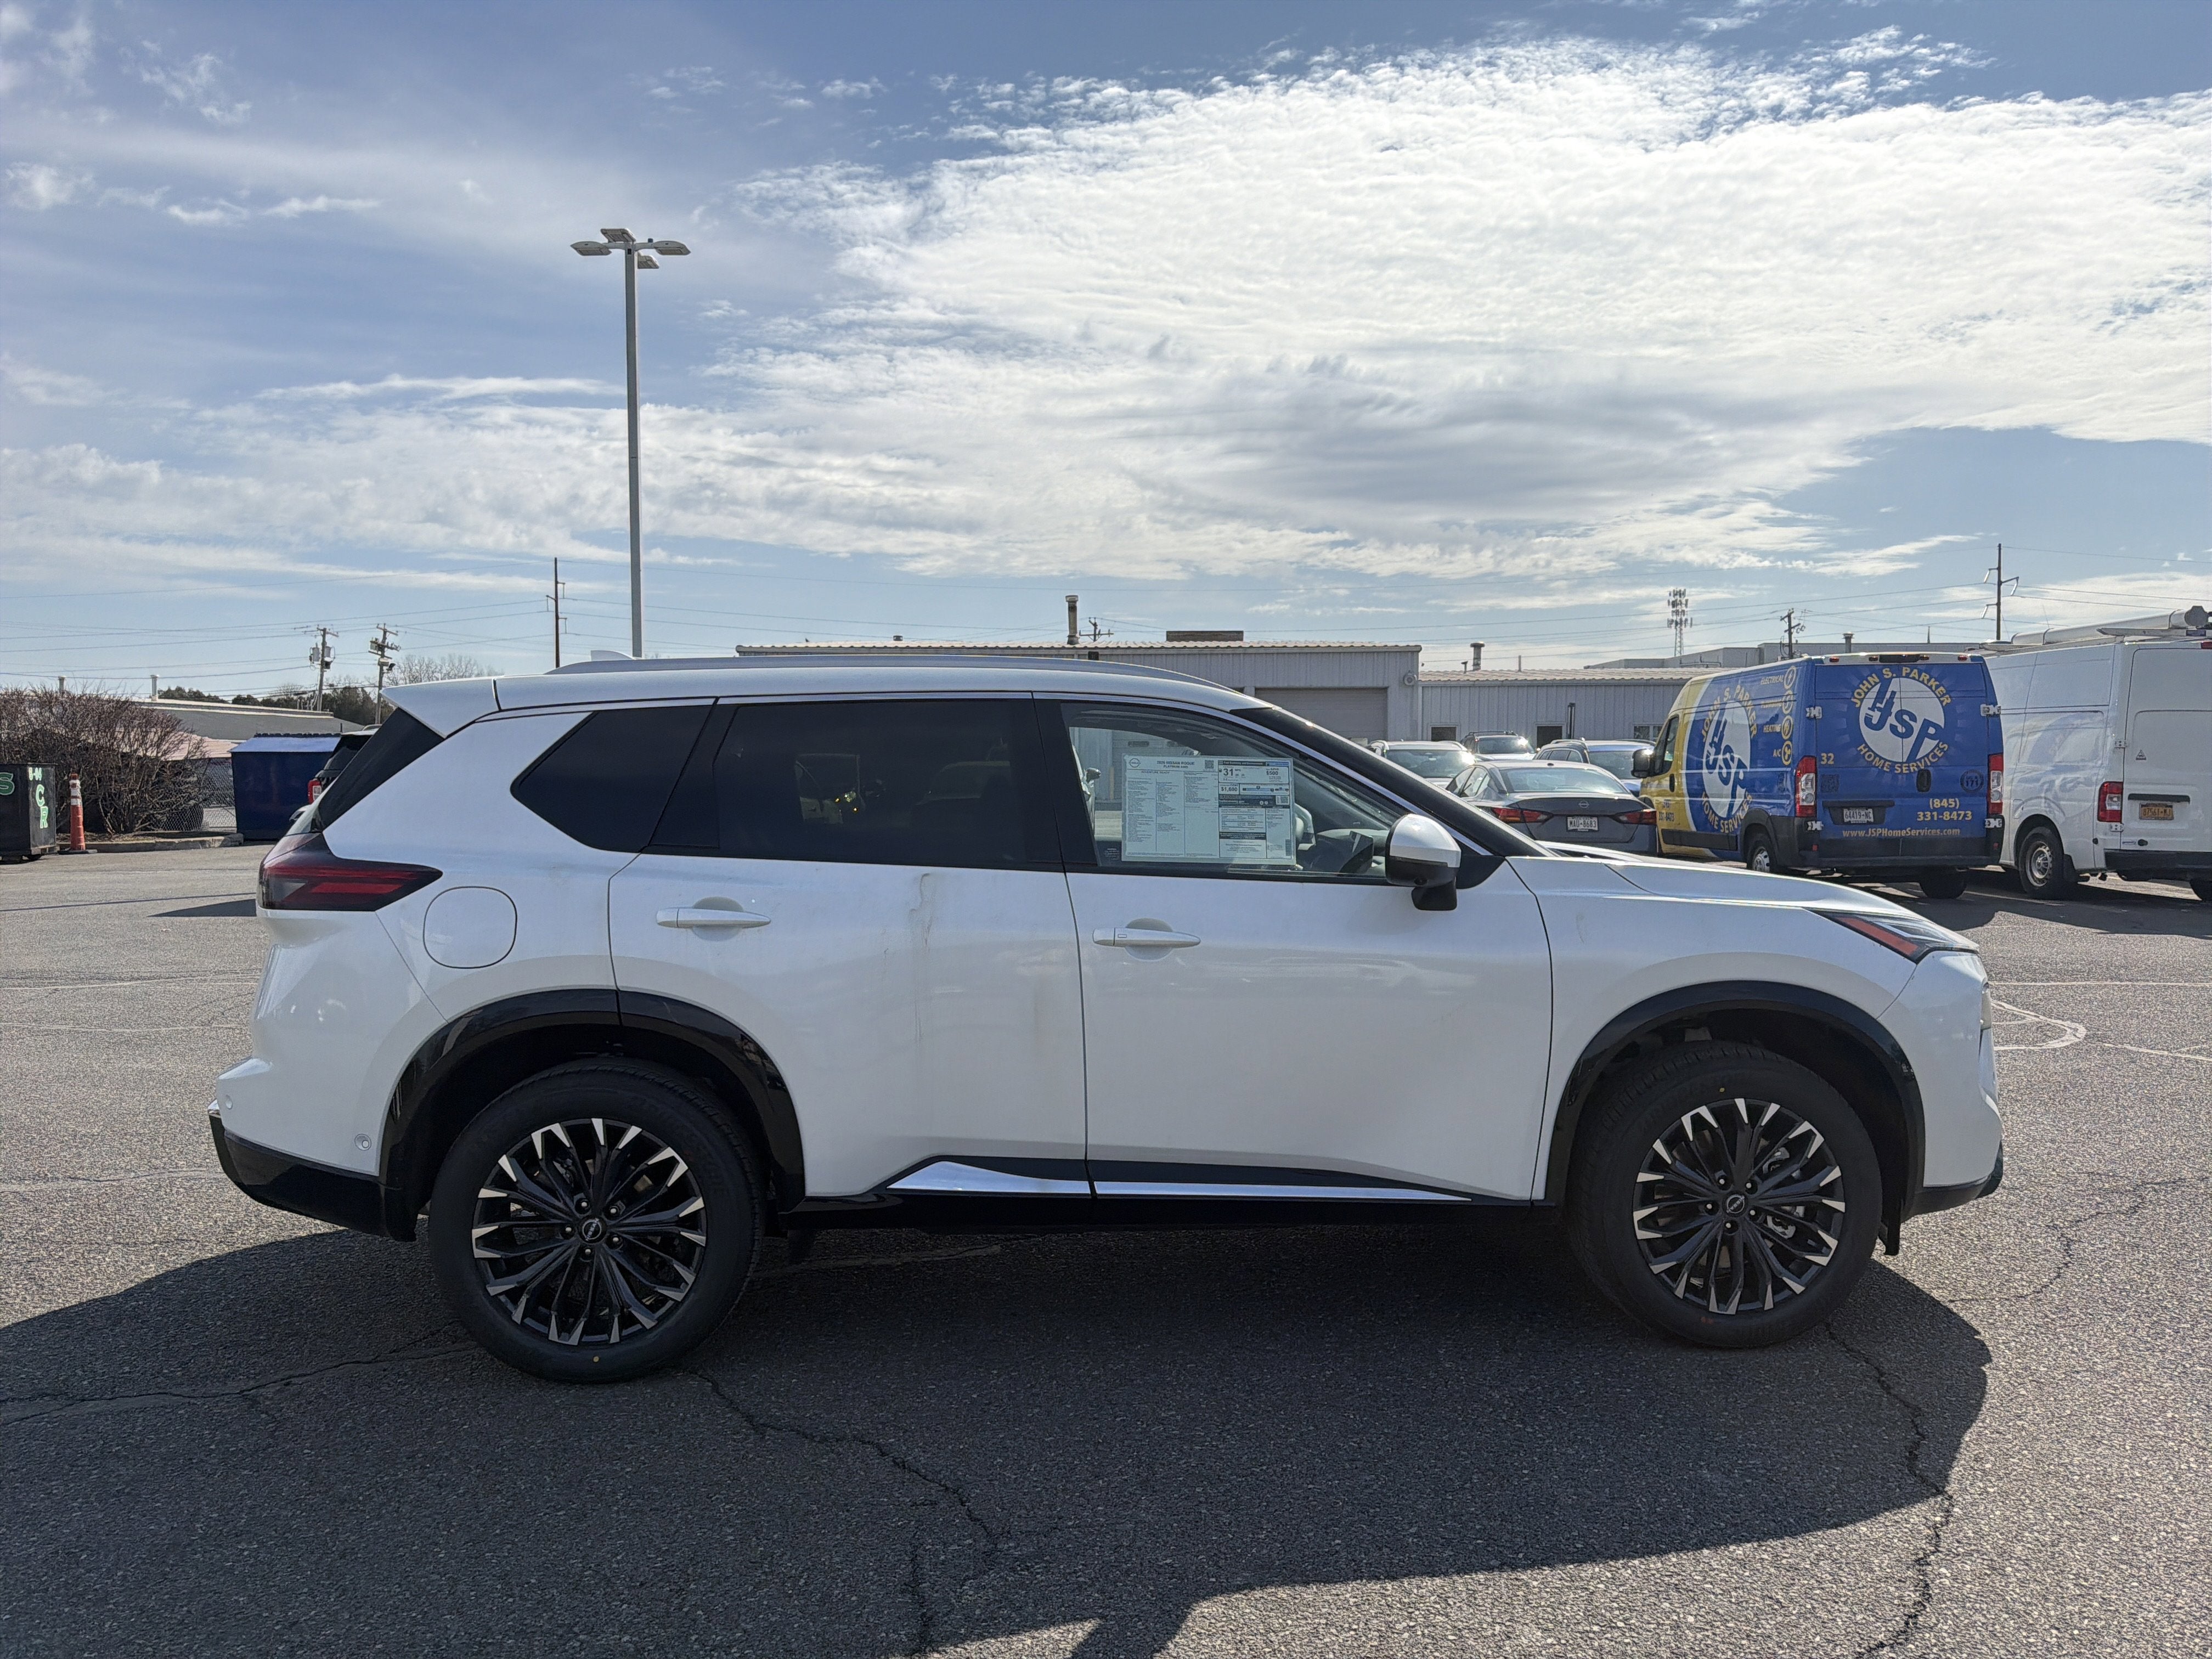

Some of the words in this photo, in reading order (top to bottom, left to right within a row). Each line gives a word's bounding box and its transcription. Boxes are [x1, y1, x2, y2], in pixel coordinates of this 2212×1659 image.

[1760, 675, 1784, 685] ELECTRICAL
[1851, 674, 1880, 708] JOHN
[1882, 668, 1896, 679] S.
[1902, 667, 1951, 706] PARKER
[1702, 696, 1721, 742] JOHN
[1724, 687, 1731, 702] S.
[1734, 685, 1757, 738] PARKER
[1763, 724, 1782, 733] HEATING
[1773, 749, 1781, 757] A/C
[1820, 753, 1834, 764] 32
[1857, 743, 1891, 772] HOME
[1895, 742, 1948, 774] SERVICES
[1223, 768, 1233, 776] 31
[1929, 798, 1960, 809] (845)
[1702, 791, 1718, 830] HOME
[1720, 791, 1752, 833] SERVICES
[1917, 811, 1973, 821] 331-8473
[1842, 827, 1961, 838] www.JSPHomeServices.com
